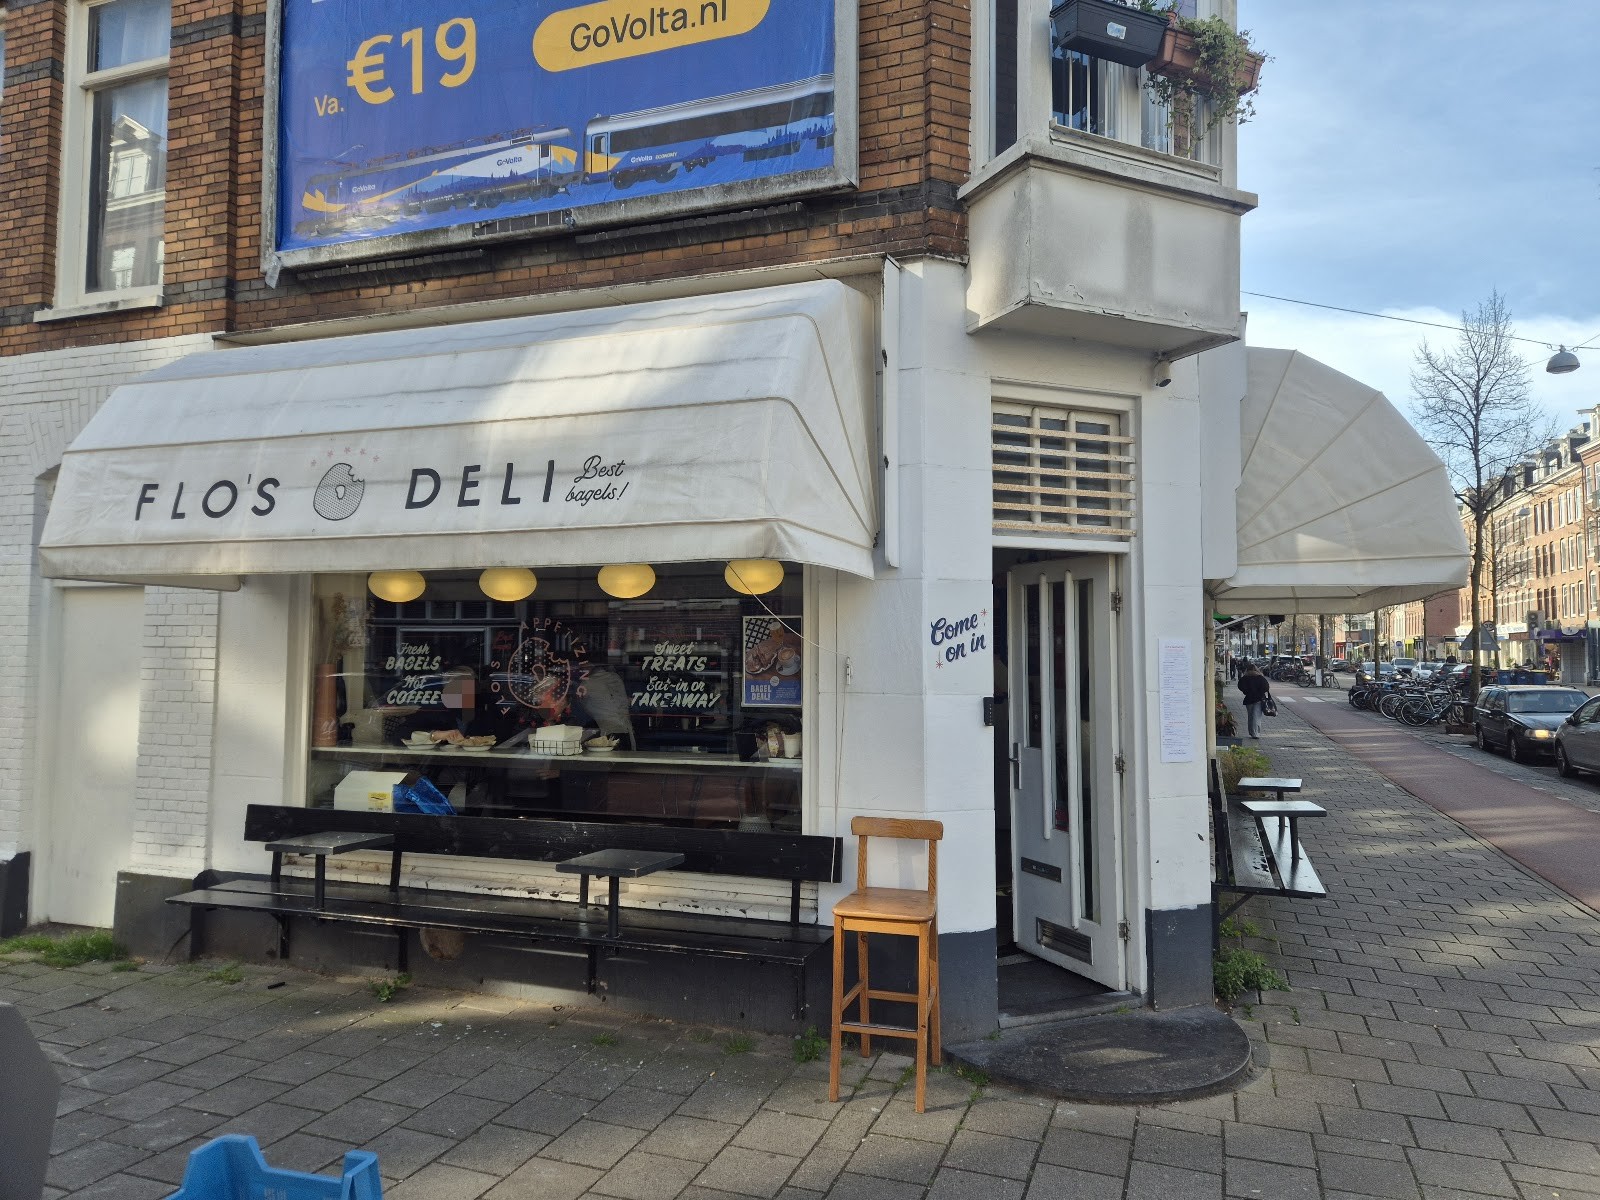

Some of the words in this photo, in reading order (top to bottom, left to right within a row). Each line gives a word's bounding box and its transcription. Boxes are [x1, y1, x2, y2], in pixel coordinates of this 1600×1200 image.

[570, 0, 727, 52] GoVolta.nl
[313, 95, 345, 117] Va.
[346, 17, 477, 105] €19
[496, 156, 523, 167] GoVolta
[351, 184, 376, 194] GoVolta
[573, 455, 626, 484] Best
[135, 473, 281, 521] FLO'S
[404, 459, 555, 510] DELI
[565, 481, 630, 507] bagels!
[930, 613, 979, 646] Come
[396, 642, 431, 655] Fresh
[654, 640, 695, 656] Sweet
[945, 642, 968, 663] on
[970, 632, 987, 653] in
[385, 655, 442, 671] BAGELS
[520, 617, 591, 698] APPETIZING
[641, 655, 708, 672] TREATS
[401, 674, 427, 690] Hot
[690, 681, 706, 692] or
[750, 684, 772, 693] BAGEL
[386, 690, 442, 705] COFFEE
[630, 691, 721, 709] TAKEAWAY
